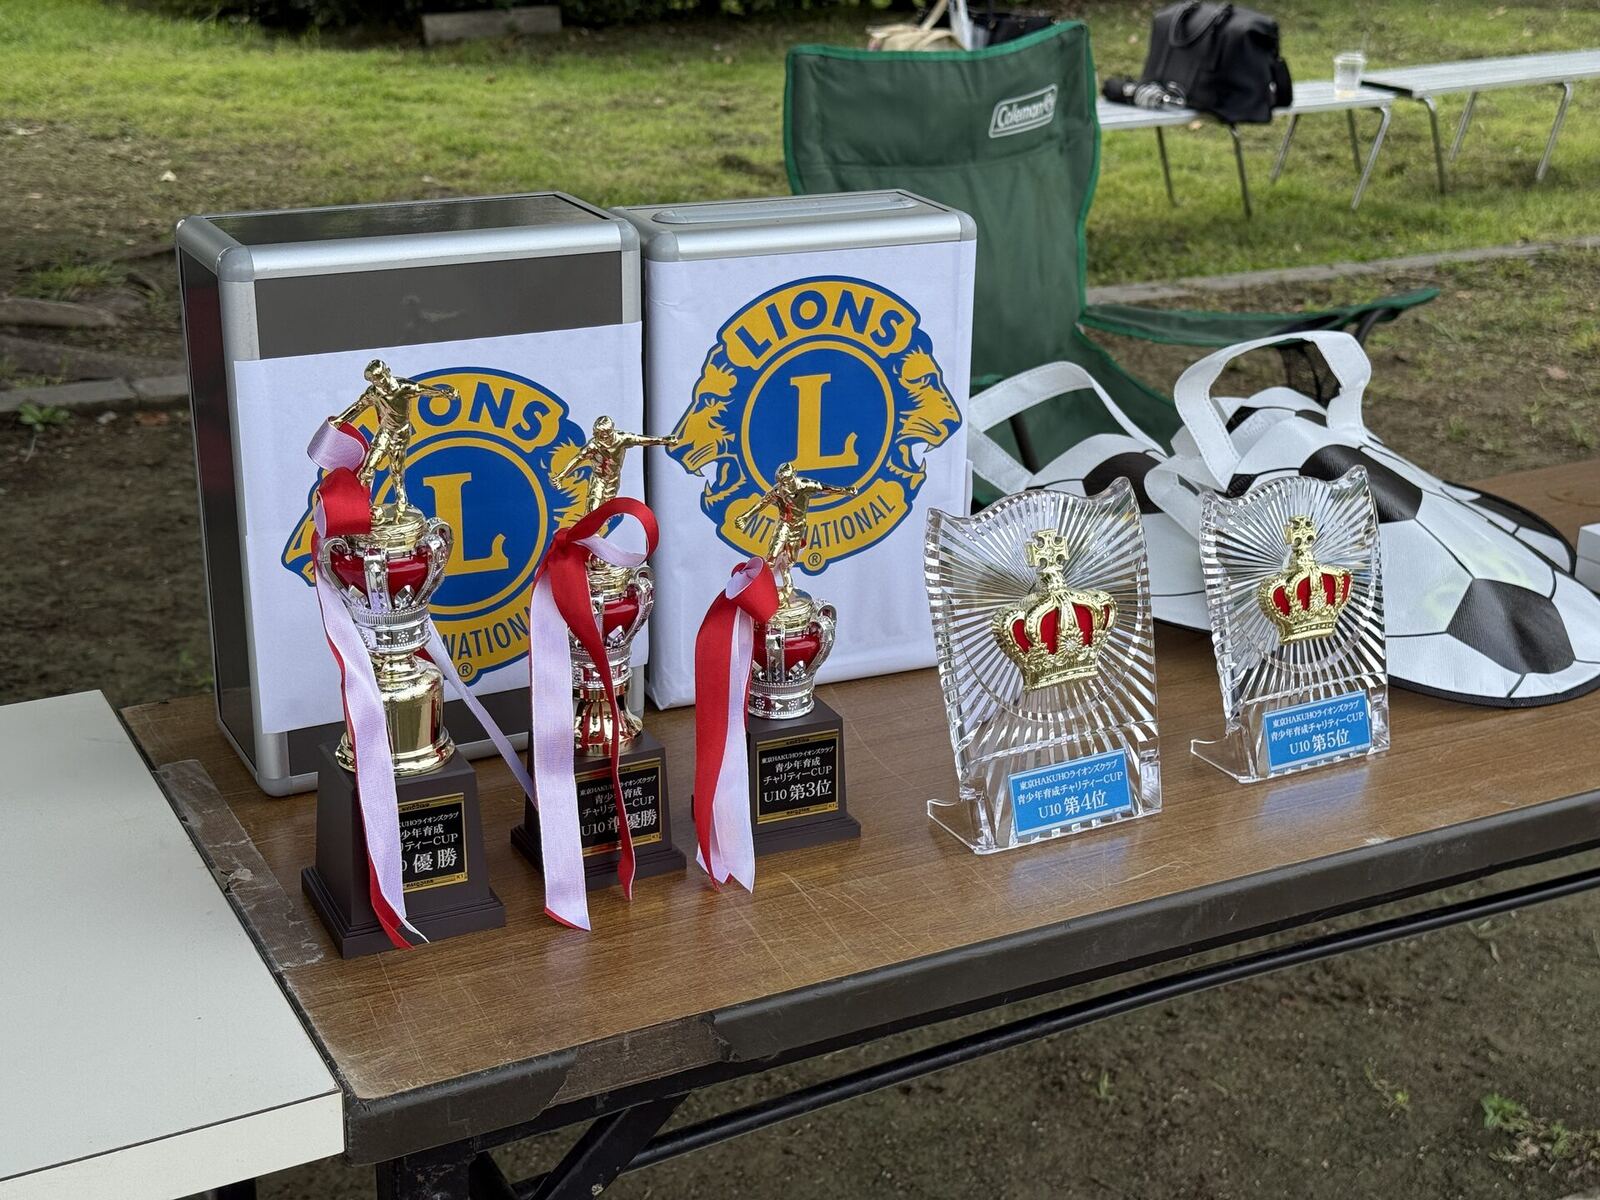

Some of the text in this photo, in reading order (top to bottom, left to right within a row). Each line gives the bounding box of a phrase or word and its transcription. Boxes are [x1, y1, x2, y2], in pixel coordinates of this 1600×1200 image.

[996, 102, 1044, 129] Coleman
[735, 290, 905, 360] LIONS
[790, 373, 859, 472] L
[423, 472, 510, 577] L
[1271, 711, 1364, 742] 青少年育成チャリティーCUP
[1272, 700, 1359, 728] 東京HAKUHOライオンズクラブ
[1289, 728, 1350, 755] U10 第5位
[763, 765, 833, 786] チャリティーCUP
[775, 756, 821, 773] 青少年育成
[1019, 759, 1118, 790] 東京HAKUHOライオンズクラブ
[595, 787, 643, 805] 青少育成
[764, 779, 832, 803] U10 第3位
[1017, 771, 1124, 805] 青少年育成チャリティーCUP
[1038, 789, 1108, 819] U10 第4位
[581, 821, 606, 836] U10
[413, 847, 458, 874] 優勝
